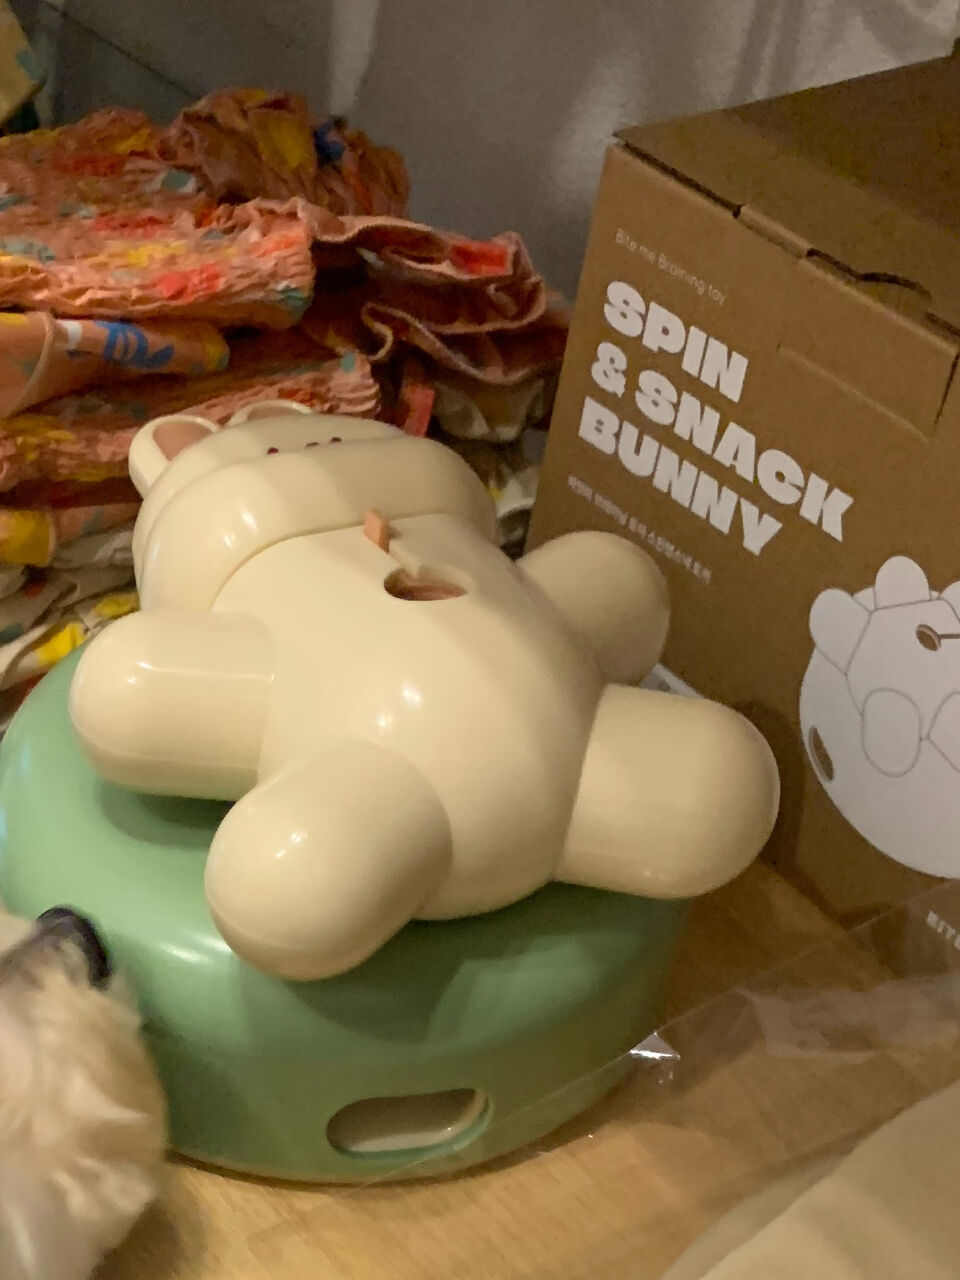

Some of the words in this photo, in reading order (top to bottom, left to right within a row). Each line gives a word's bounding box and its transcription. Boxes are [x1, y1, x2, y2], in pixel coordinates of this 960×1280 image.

[603, 280, 749, 403] SPIN
[578, 396, 783, 556] BUNNY
[591, 341, 628, 398] &
[634, 369, 854, 543] SNACK
